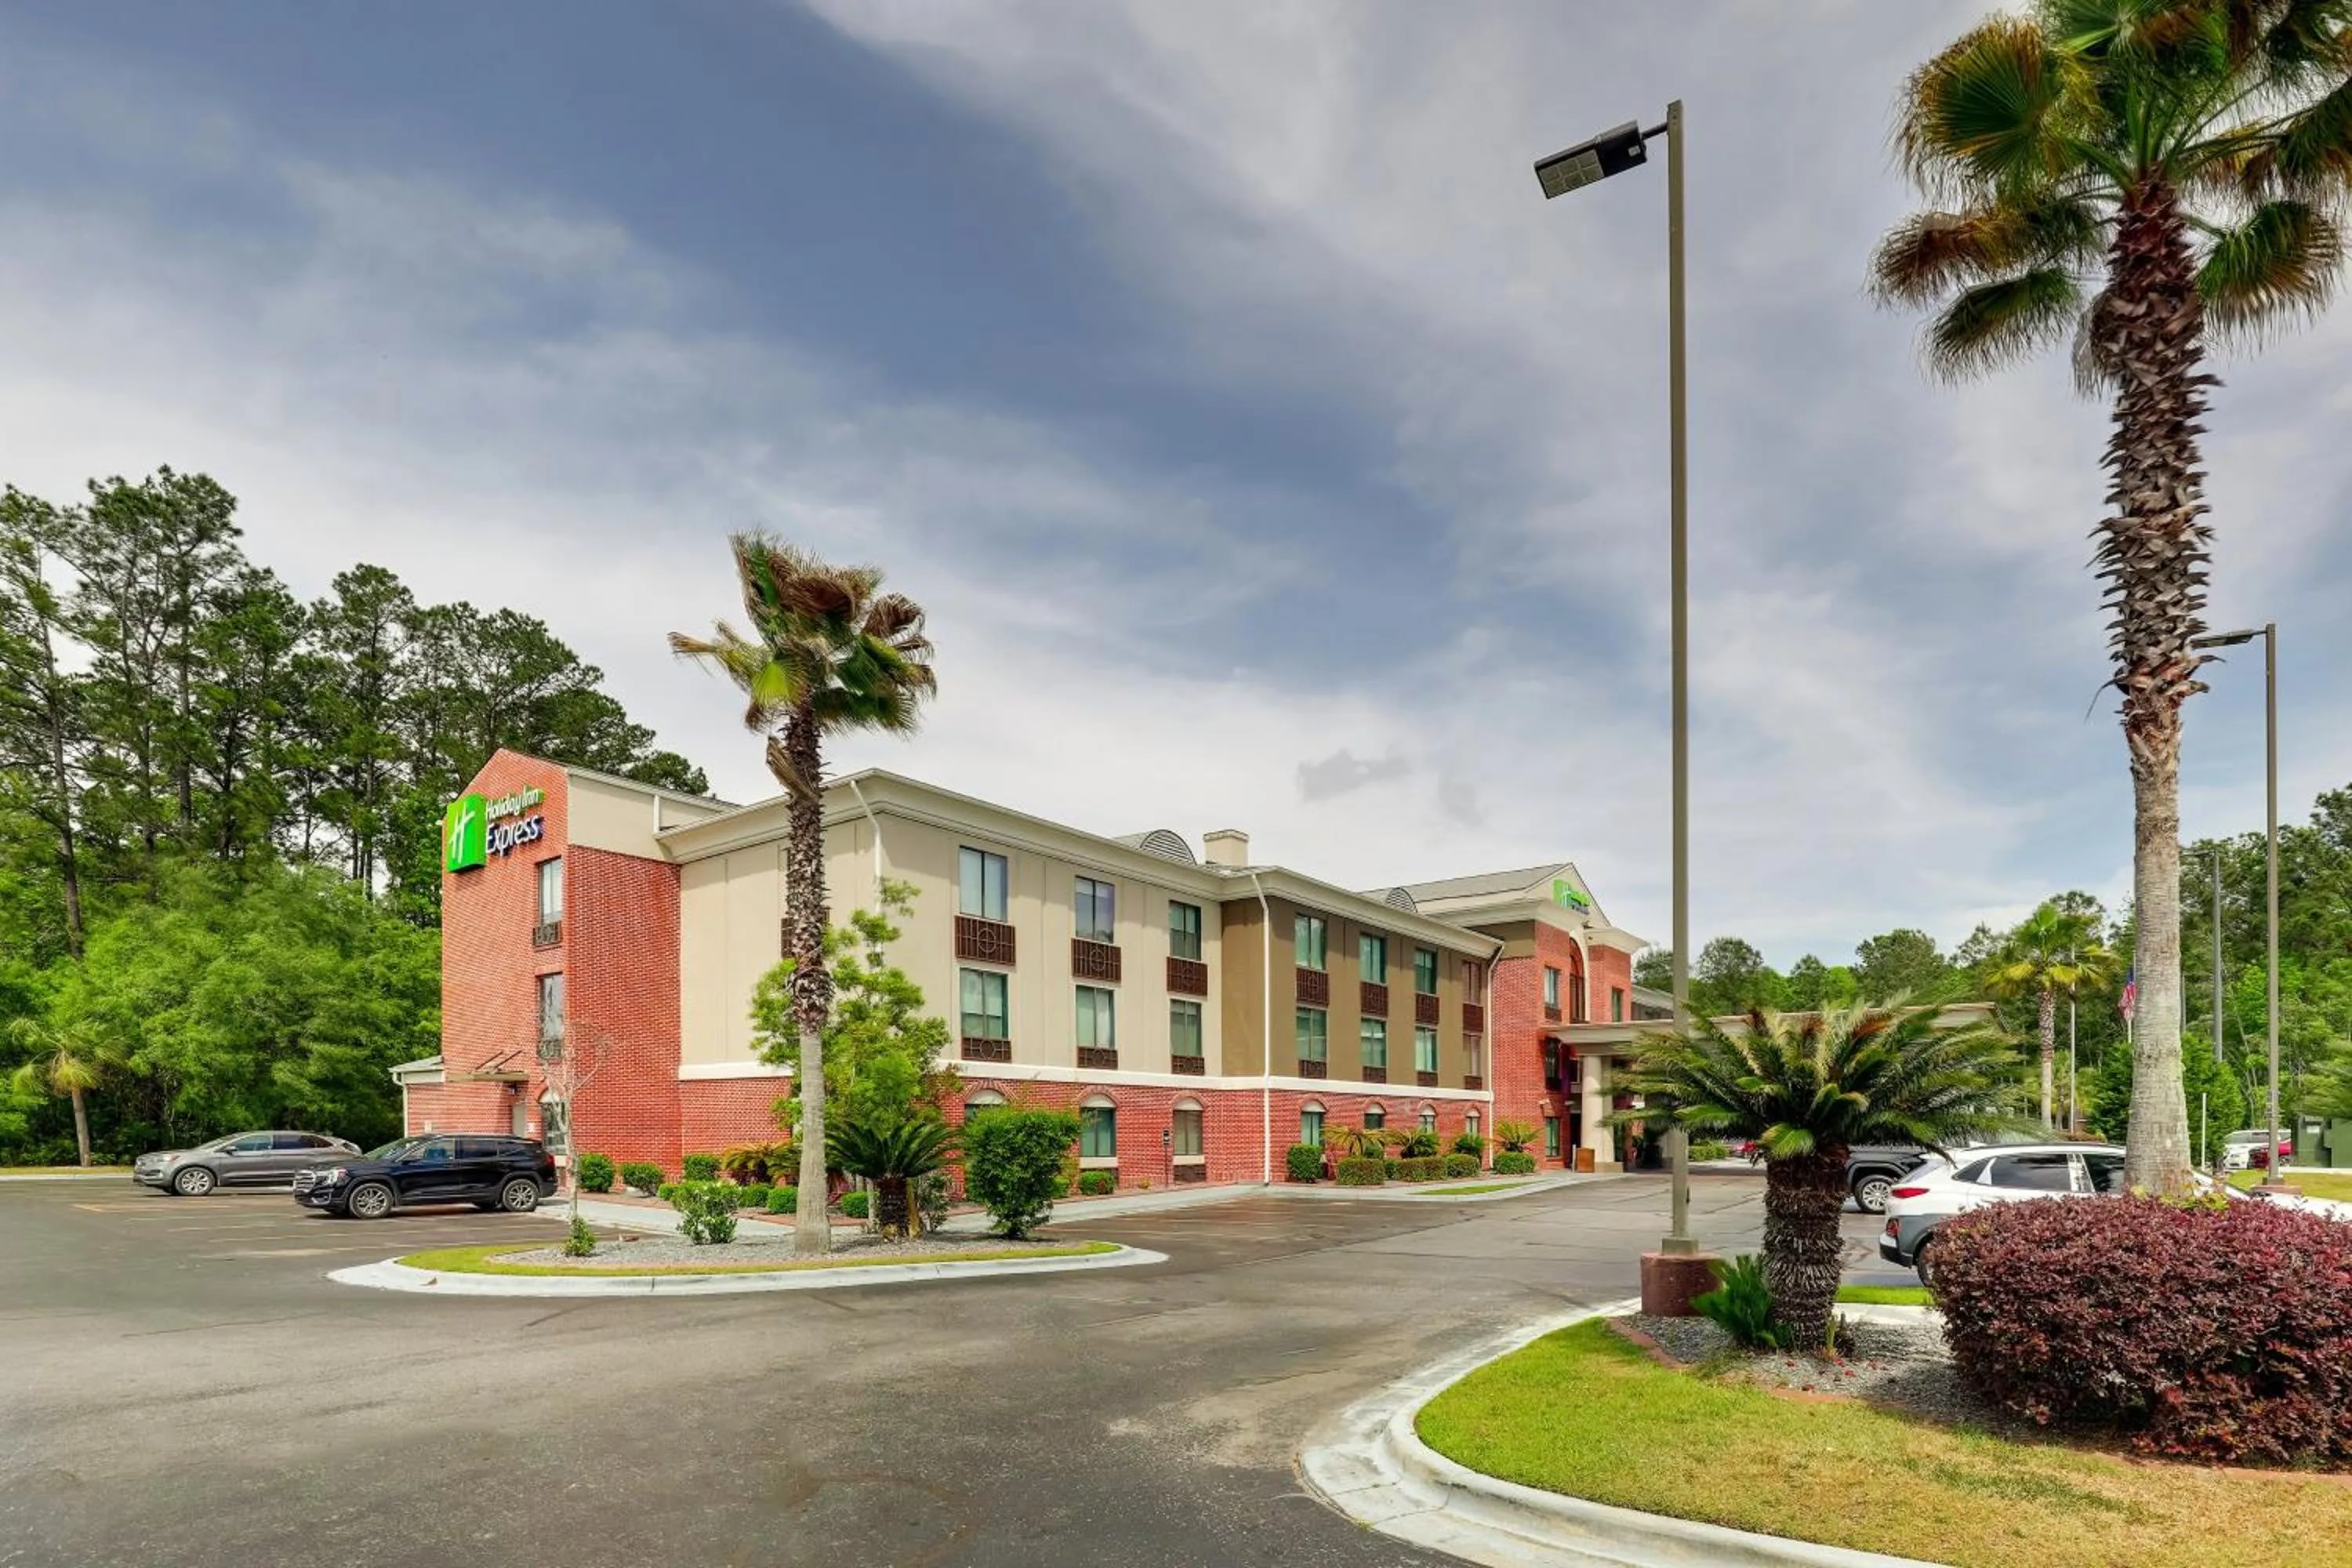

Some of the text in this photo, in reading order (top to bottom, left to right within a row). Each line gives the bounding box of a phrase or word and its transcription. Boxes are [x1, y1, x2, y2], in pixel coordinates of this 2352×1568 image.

[486, 785, 541, 821] Holiday Inn
[486, 815, 540, 857] Express
